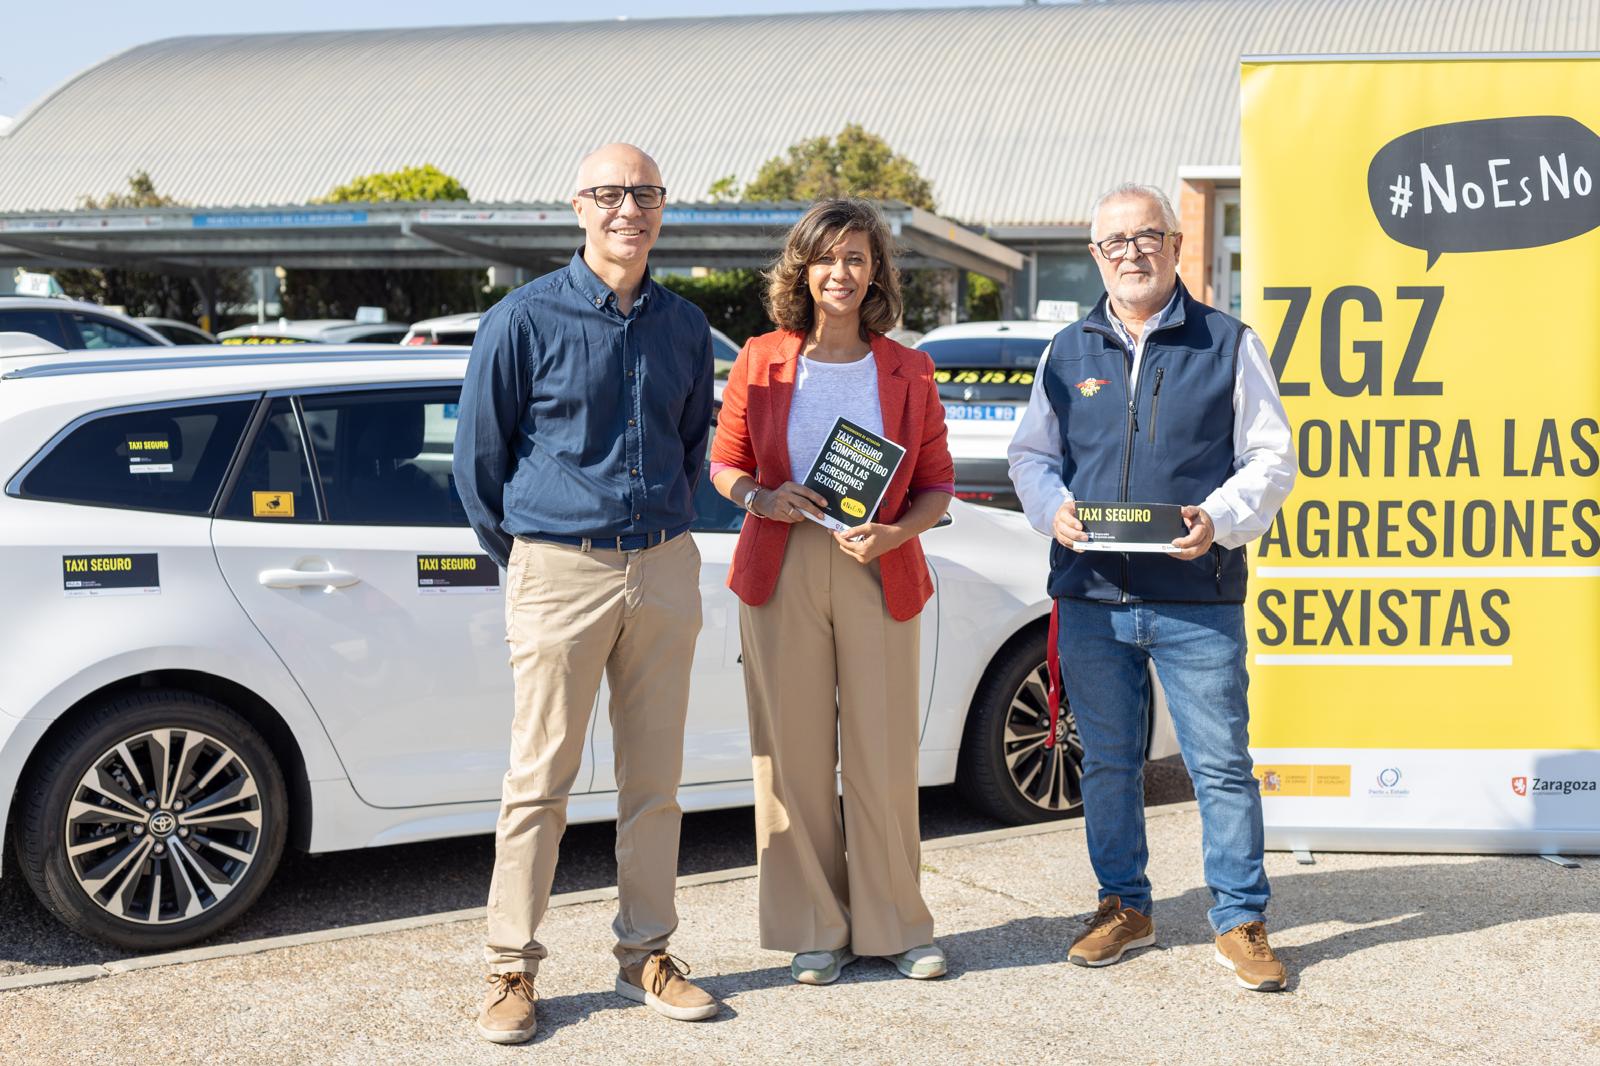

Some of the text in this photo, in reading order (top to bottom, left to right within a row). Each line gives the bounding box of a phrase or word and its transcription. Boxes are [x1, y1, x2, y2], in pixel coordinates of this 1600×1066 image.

[1263, 285, 1445, 397] ZGZ
[128, 440, 169, 450] TAXI SEGURO
[831, 441, 889, 477] COMPROMETIDO
[836, 430, 883, 461] TAXI SEGURO
[1297, 418, 1600, 478] ONTRA LAS
[819, 462, 865, 491] AGRESIONES
[825, 452, 870, 480] CONTRA LAS
[814, 472, 848, 496] SEXISTAS
[1078, 508, 1151, 522] TAXI SEGURO
[1258, 498, 1600, 558] AGRESIONES
[65, 557, 132, 572] TAXI SEGURO
[419, 558, 477, 571] TAXI SEGURO
[1256, 588, 1511, 647] SEXISTAS
[1532, 778, 1597, 795] Zaragoza
